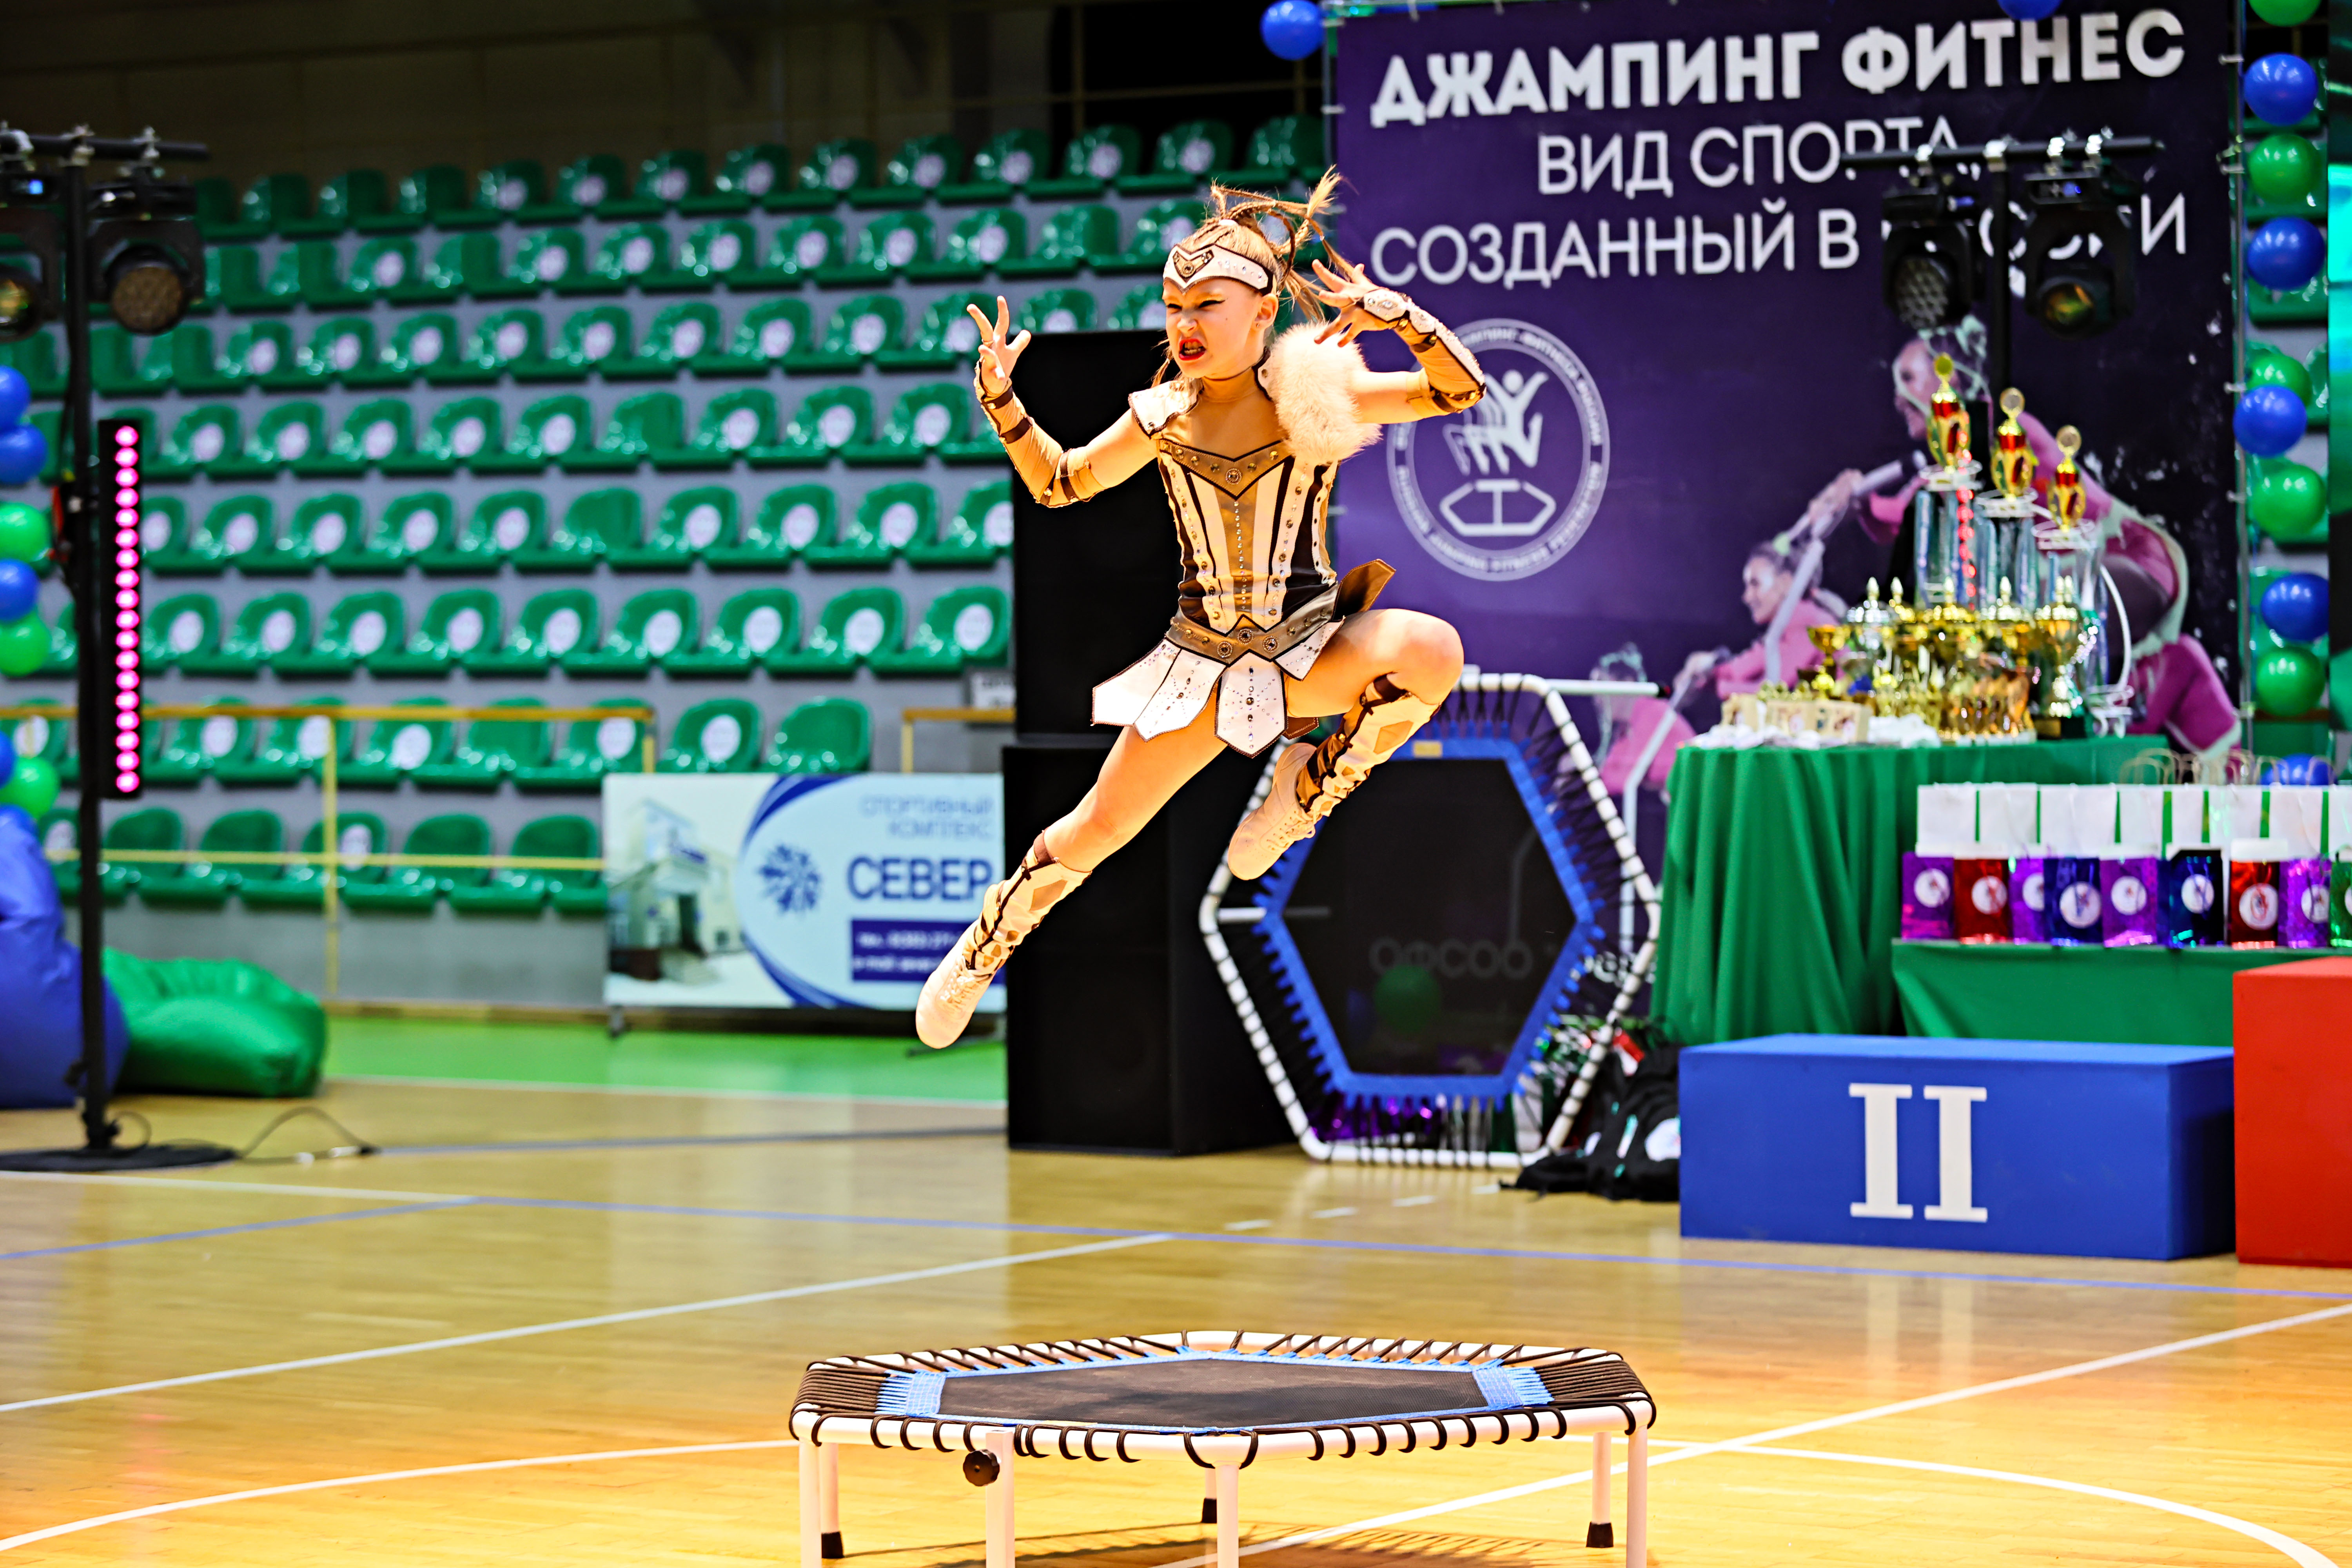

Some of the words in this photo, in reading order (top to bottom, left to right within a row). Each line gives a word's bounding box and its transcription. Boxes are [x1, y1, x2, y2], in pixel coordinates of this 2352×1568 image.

[1371, 31, 1819, 128] ДЖАМПИНГ
[1841, 8, 2185, 94] ФИТНЕС
[1538, 130, 1674, 200] ВИД
[1370, 197, 1795, 290] СОЗДАННЫЙ
[1818, 208, 1860, 270] В
[847, 855, 993, 901] СЕВЕР
[1849, 1083, 1988, 1223] II
